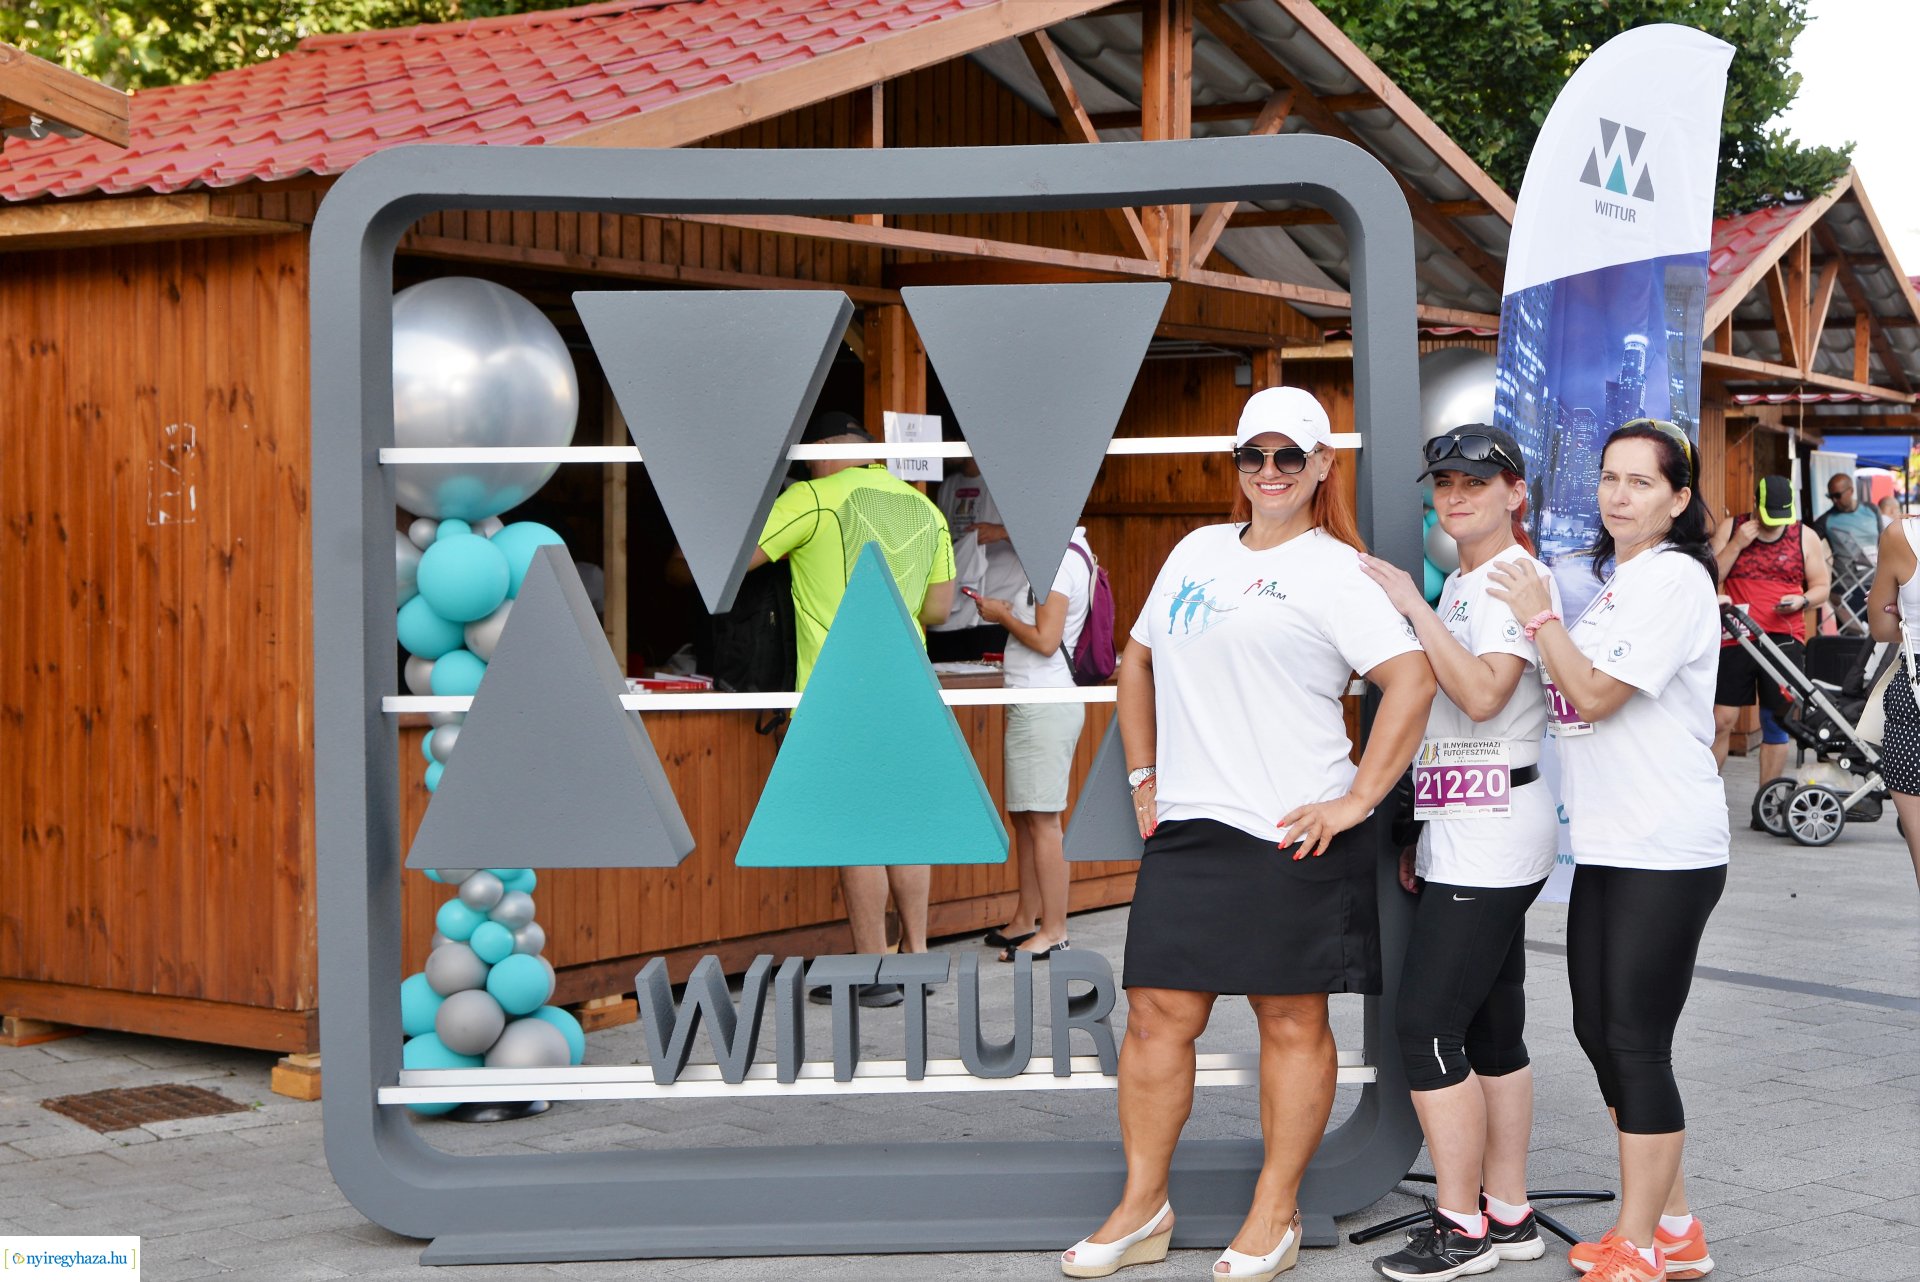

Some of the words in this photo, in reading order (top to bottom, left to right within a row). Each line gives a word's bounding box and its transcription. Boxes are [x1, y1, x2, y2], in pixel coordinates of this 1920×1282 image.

[1595, 199, 1636, 223] WITTUR
[895, 457, 929, 471] WITTUR
[1266, 589, 1287, 601] TKM
[1418, 768, 1506, 800] 21220
[634, 951, 1118, 1085] WITTUR
